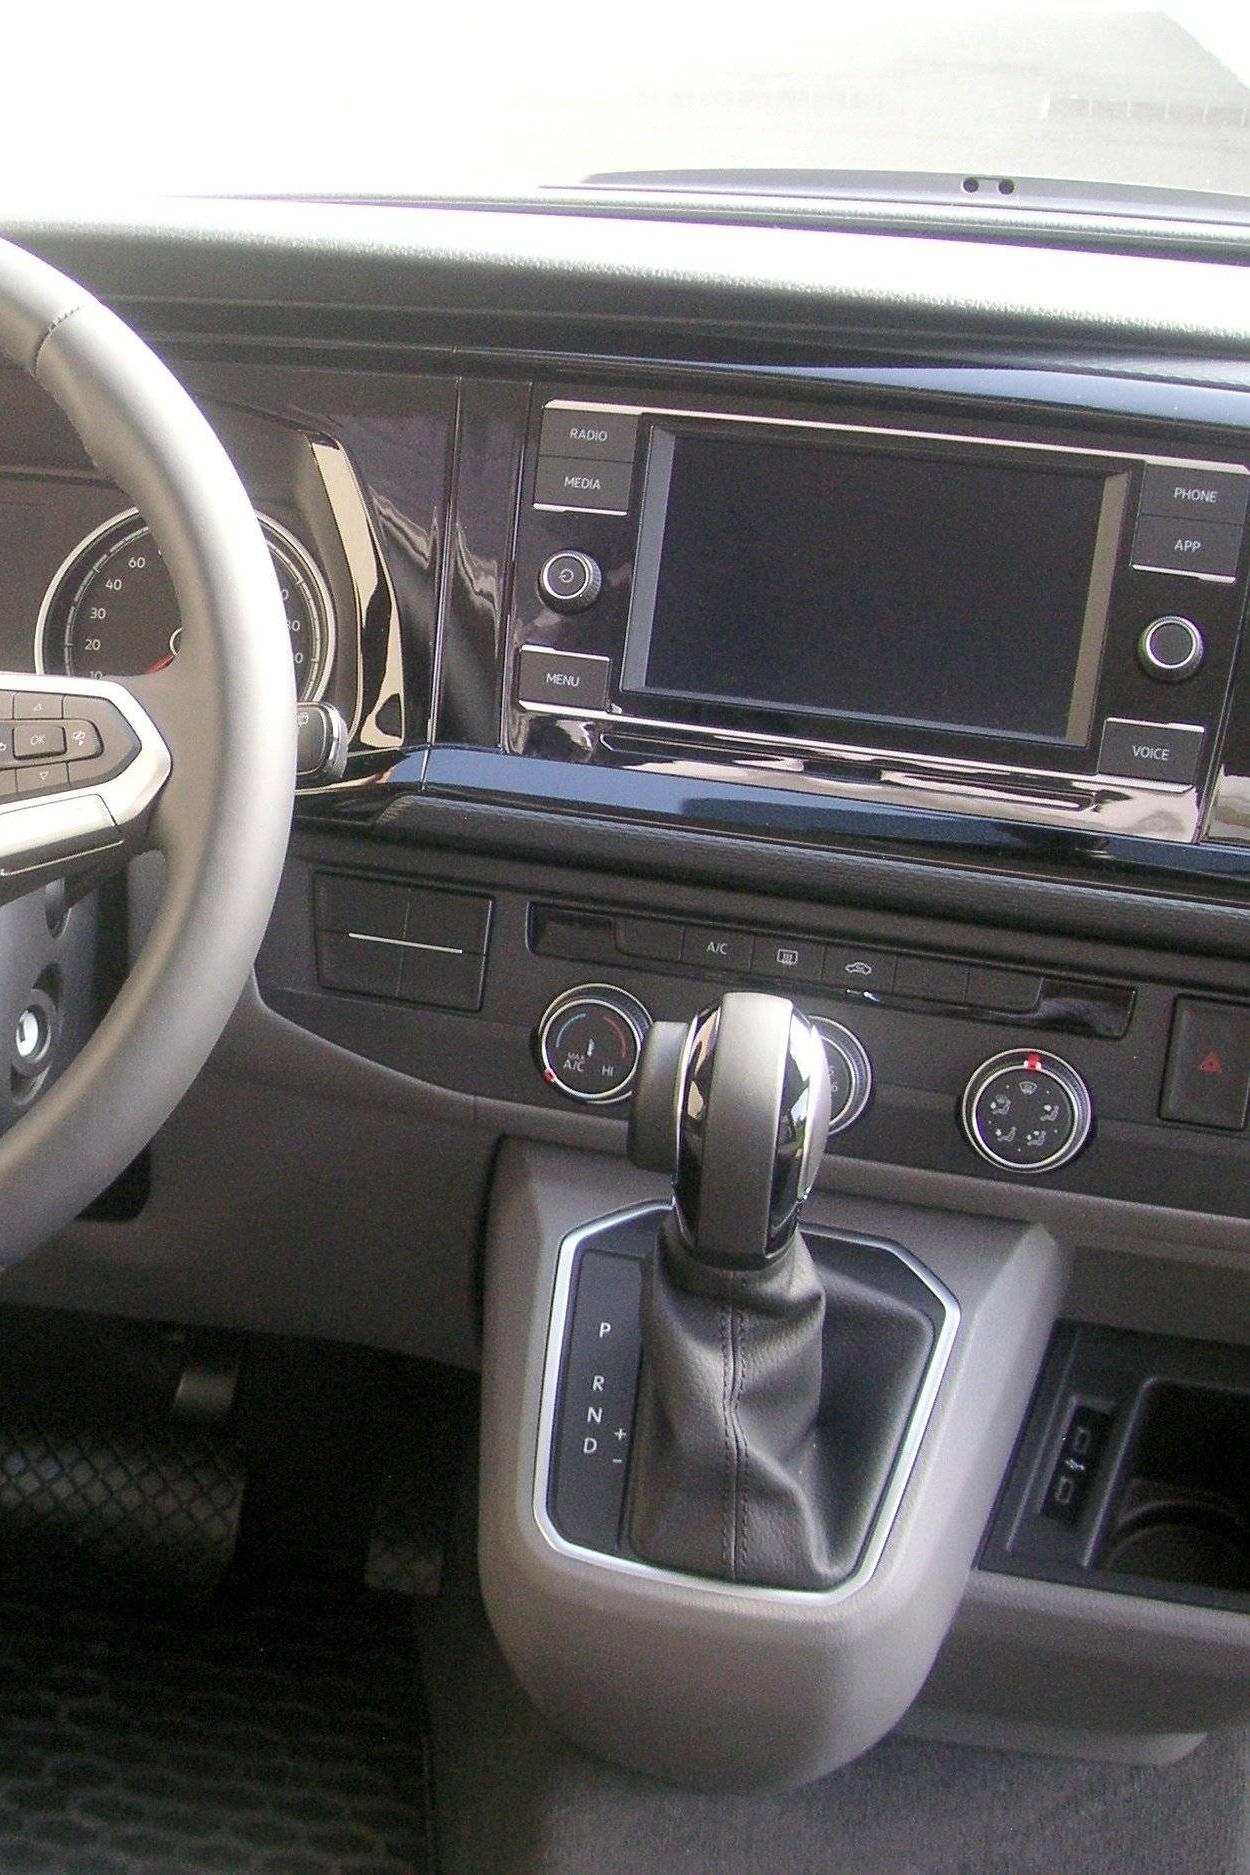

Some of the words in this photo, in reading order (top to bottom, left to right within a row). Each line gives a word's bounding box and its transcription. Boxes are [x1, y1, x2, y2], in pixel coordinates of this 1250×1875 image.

[569, 428, 608, 443] RADIO
[564, 475, 601, 491] MEDIA
[1173, 487, 1218, 504] PHONE
[1174, 538, 1201, 553] APP
[127, 556, 146, 569] 60
[105, 578, 123, 591] 40
[89, 607, 107, 620] 30
[84, 638, 101, 651] 20
[545, 672, 580, 688] MENU
[30, 735, 46, 746] OK
[1132, 745, 1170, 761] VOICE
[706, 941, 728, 955] A/C
[563, 1059, 586, 1073] A/C
[601, 1064, 615, 1077] HI
[599, 1322, 611, 1338] P
[592, 1375, 605, 1392] R
[587, 1407, 603, 1424] N
[583, 1437, 598, 1454] D
